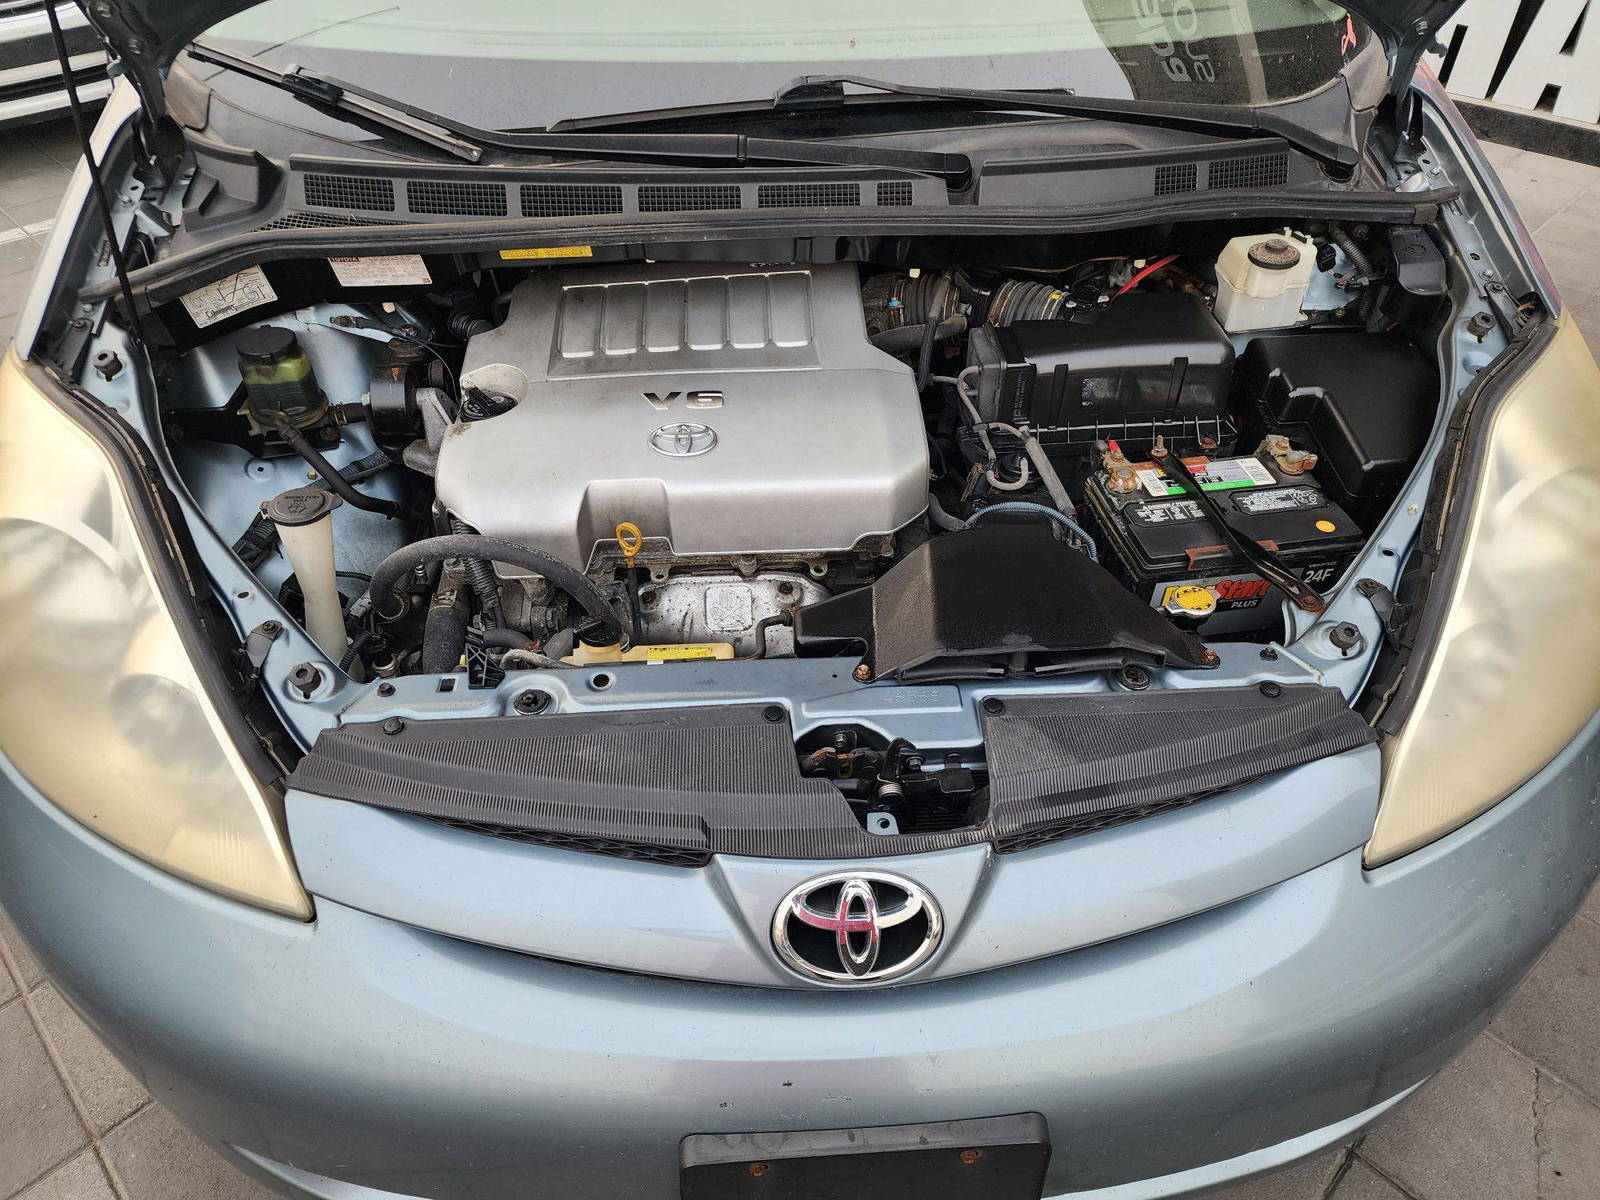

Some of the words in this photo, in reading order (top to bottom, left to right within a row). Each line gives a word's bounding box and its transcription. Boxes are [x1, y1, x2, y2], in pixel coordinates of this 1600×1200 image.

[640, 390, 724, 410] V6
[1303, 567, 1335, 583] 24F
[1231, 599, 1258, 609] PLUS
